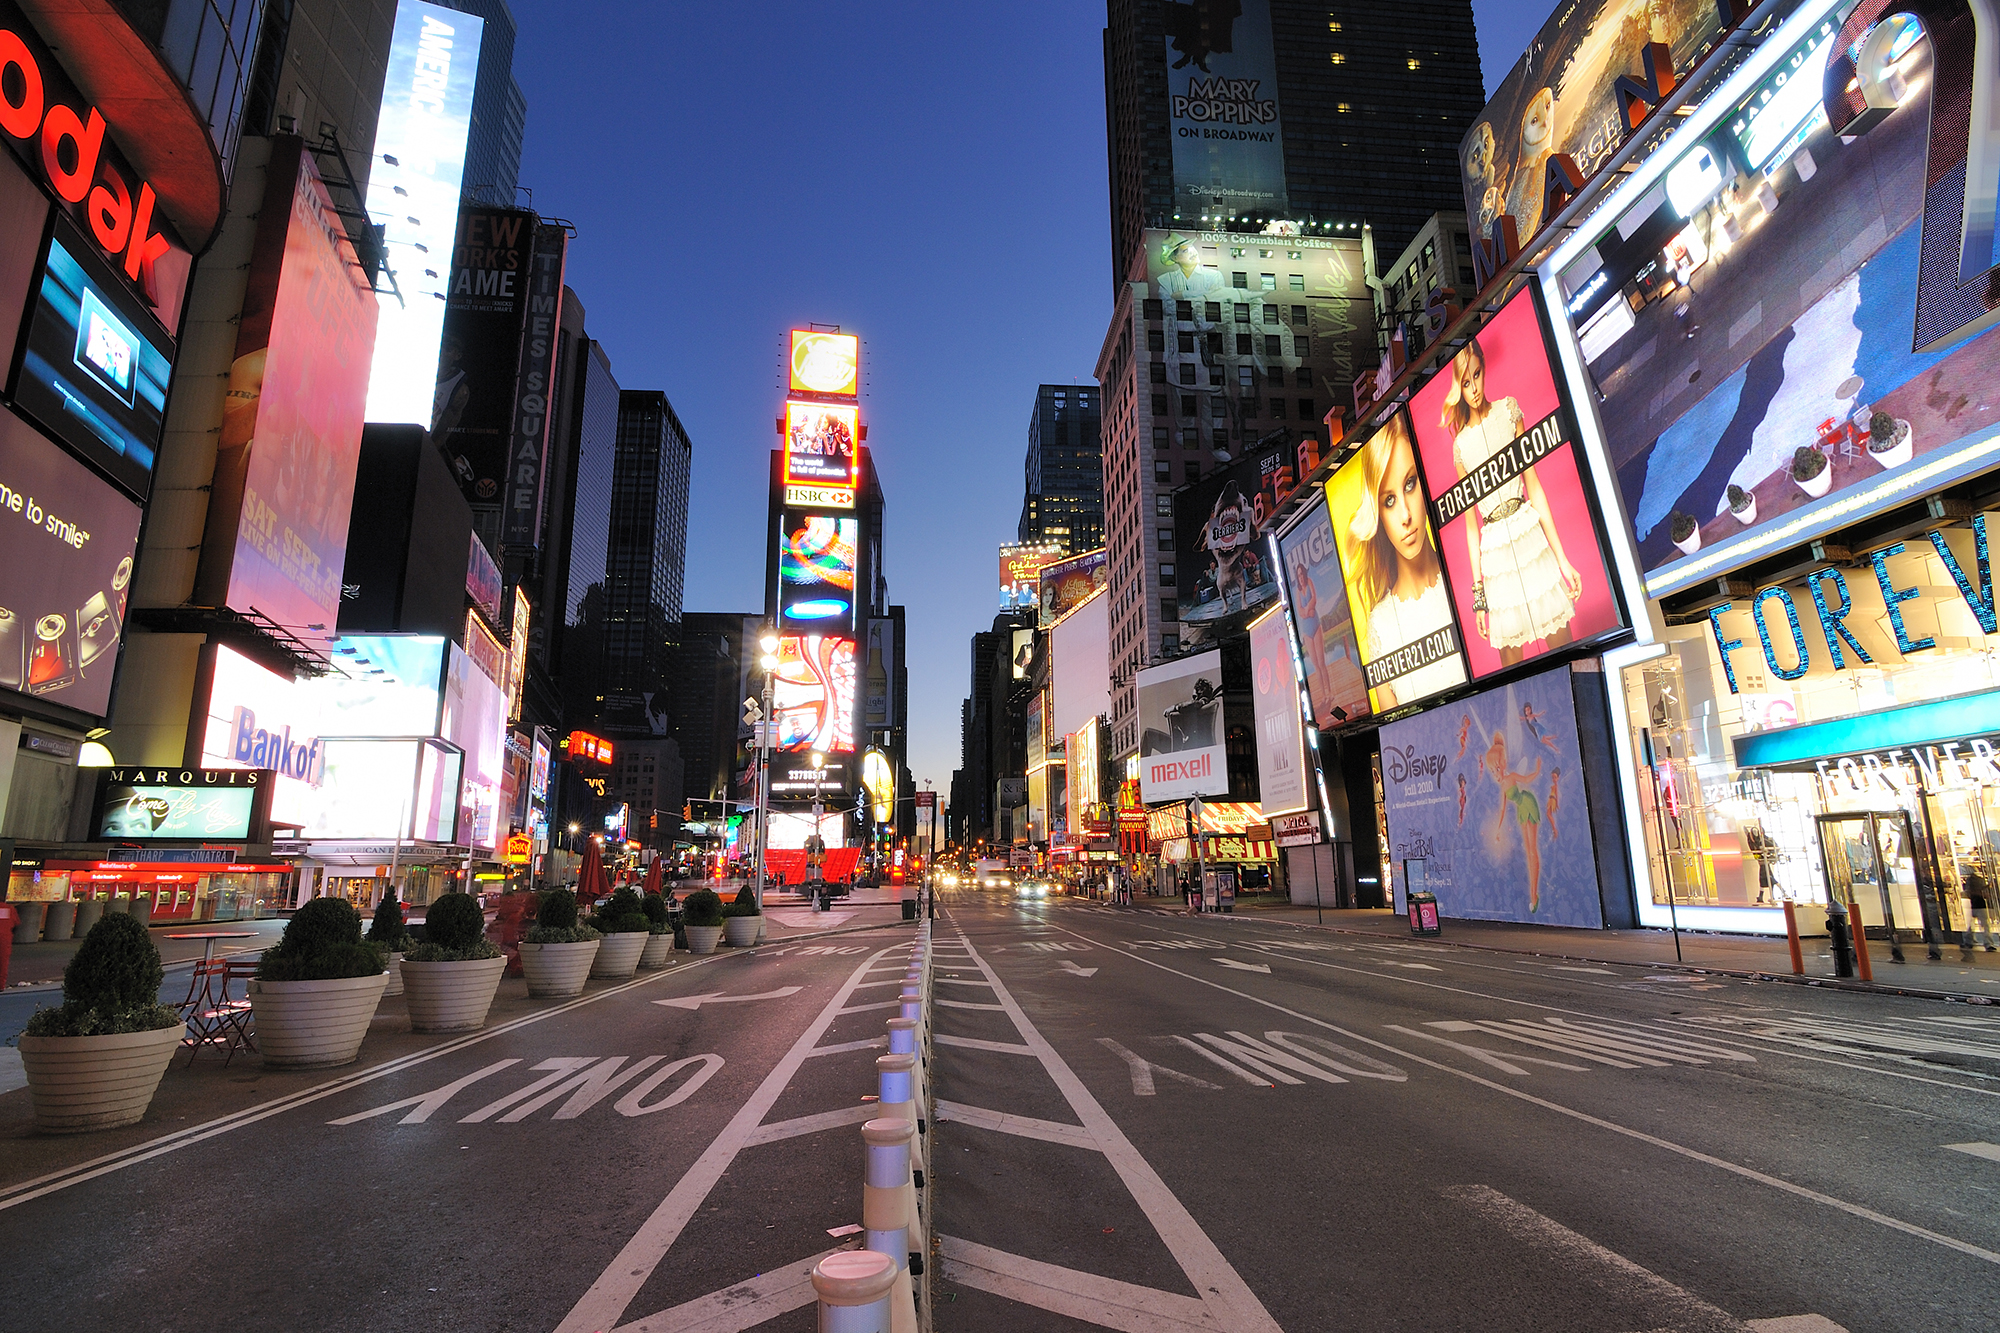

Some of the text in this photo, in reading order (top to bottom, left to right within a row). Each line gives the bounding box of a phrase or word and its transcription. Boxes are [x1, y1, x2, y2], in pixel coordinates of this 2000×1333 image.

[1189, 76, 1261, 102] MARY
[1732, 21, 1832, 137] MARQUIS
[1172, 96, 1277, 124] POPPINS
[1178, 127, 1275, 143] ON BROADWAY
[1201, 233, 1228, 243] 100%
[1230, 235, 1293, 247] Colombian
[455, 247, 519, 270] ORK'S
[513, 253, 559, 511] TIMES SQUARE
[790, 456, 824, 467] The world
[1260, 452, 1281, 471] SEPT 8
[1437, 414, 1563, 523] FOREVER21.COM
[787, 489, 829, 503] HSBC
[26, 497, 45, 526] to
[240, 518, 265, 553] LIVE
[266, 543, 281, 567] ON
[511, 526, 530, 534] NYC
[1212, 519, 1246, 540] TERRIERS
[243, 487, 340, 599] SAT. SEPT. 25
[1286, 520, 1335, 585] HUGE
[1020, 553, 1041, 562] The
[1012, 569, 1041, 580] Famil
[1707, 511, 1999, 695] FOREV
[1367, 628, 1456, 687] FOREVER21.COM
[232, 706, 322, 782] Bank of
[109, 770, 259, 785] MARQUIS
[1151, 753, 1211, 784] maxell
[1003, 784, 1012, 793] &
[1404, 781, 1434, 797] fall 2010
[126, 787, 243, 834] Come Fly Away
[135, 849, 165, 863] THARP
[189, 850, 227, 863] SINATRA
[510, 842, 530, 854] ROXY
[755, 945, 870, 957] ONLY
[1385, 1015, 1758, 1076] ONLY
[1096, 1029, 1409, 1096] ONLY
[324, 1052, 727, 1126] ONLY
